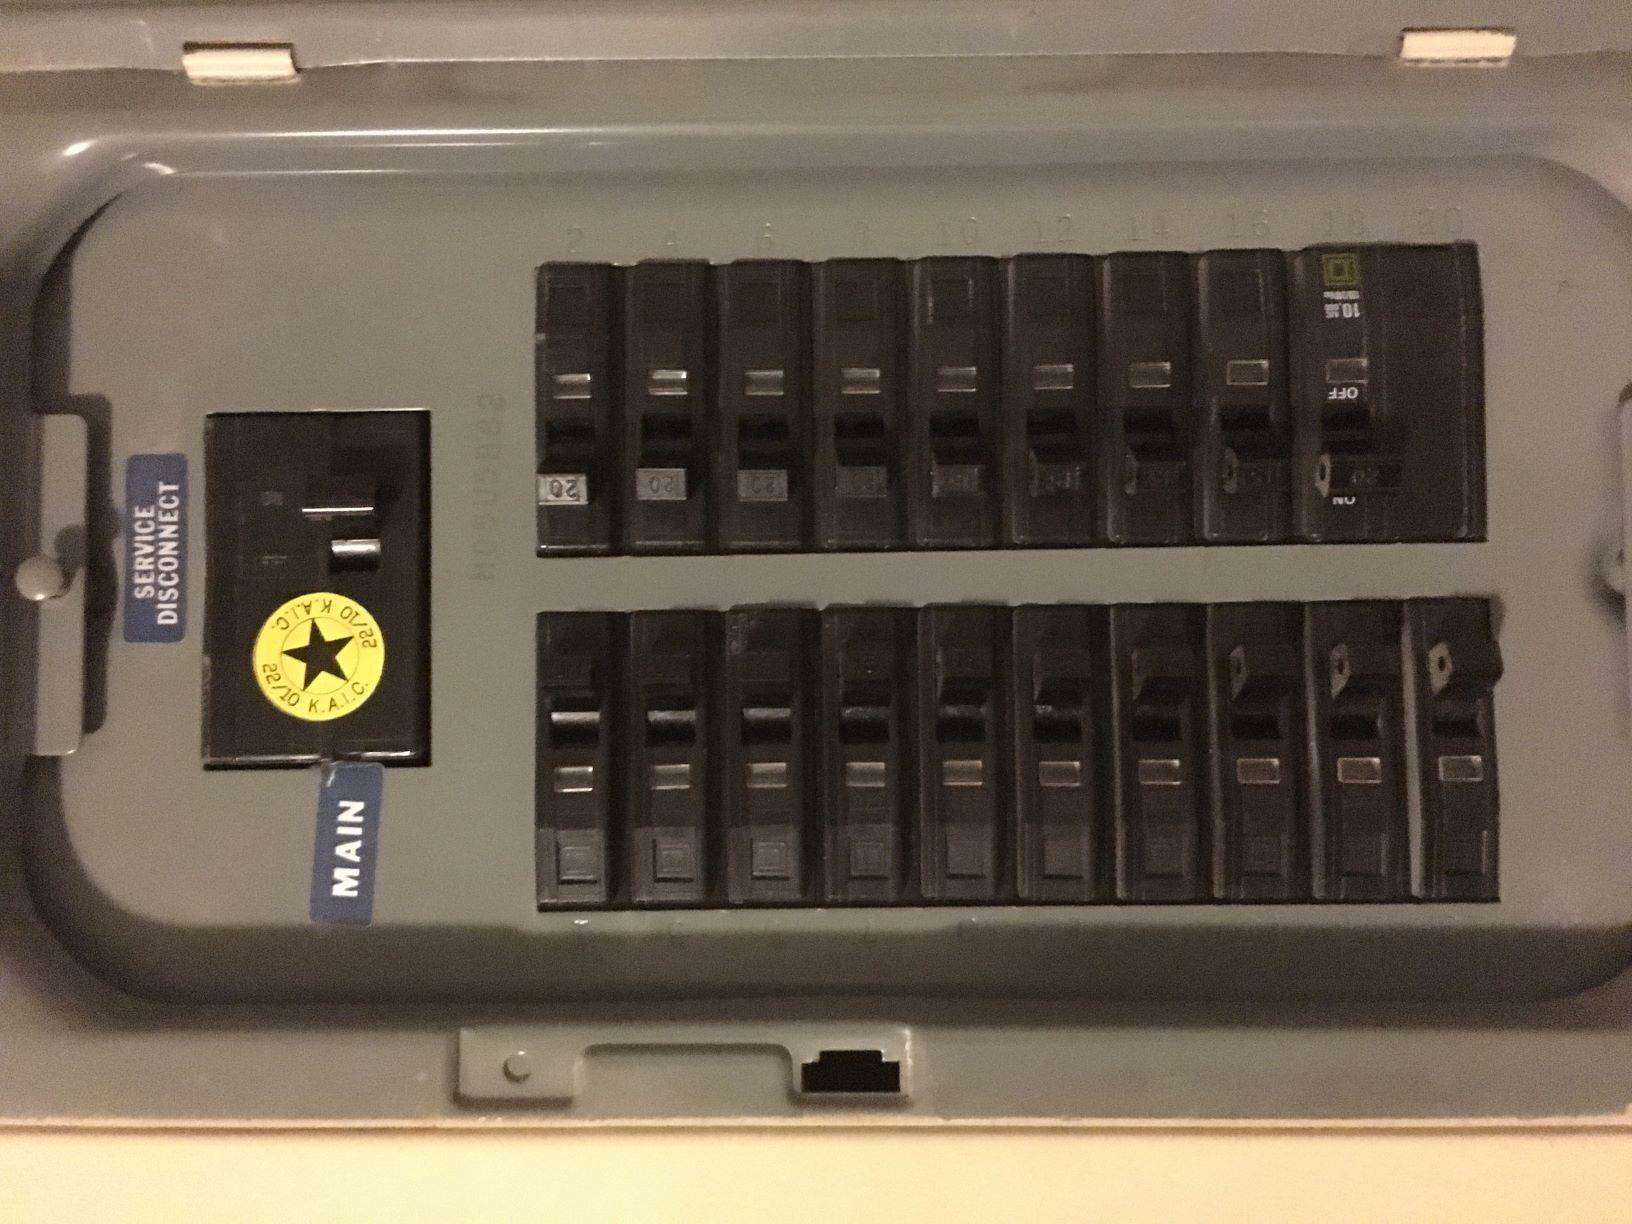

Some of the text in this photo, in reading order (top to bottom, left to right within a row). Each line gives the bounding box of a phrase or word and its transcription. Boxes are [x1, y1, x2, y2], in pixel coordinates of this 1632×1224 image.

[1328, 387, 1359, 400] OFF
[549, 478, 580, 499] 20
[134, 504, 156, 600] SERVICE
[157, 481, 180, 626] DISCONNECT
[332, 800, 365, 898] MAIN
